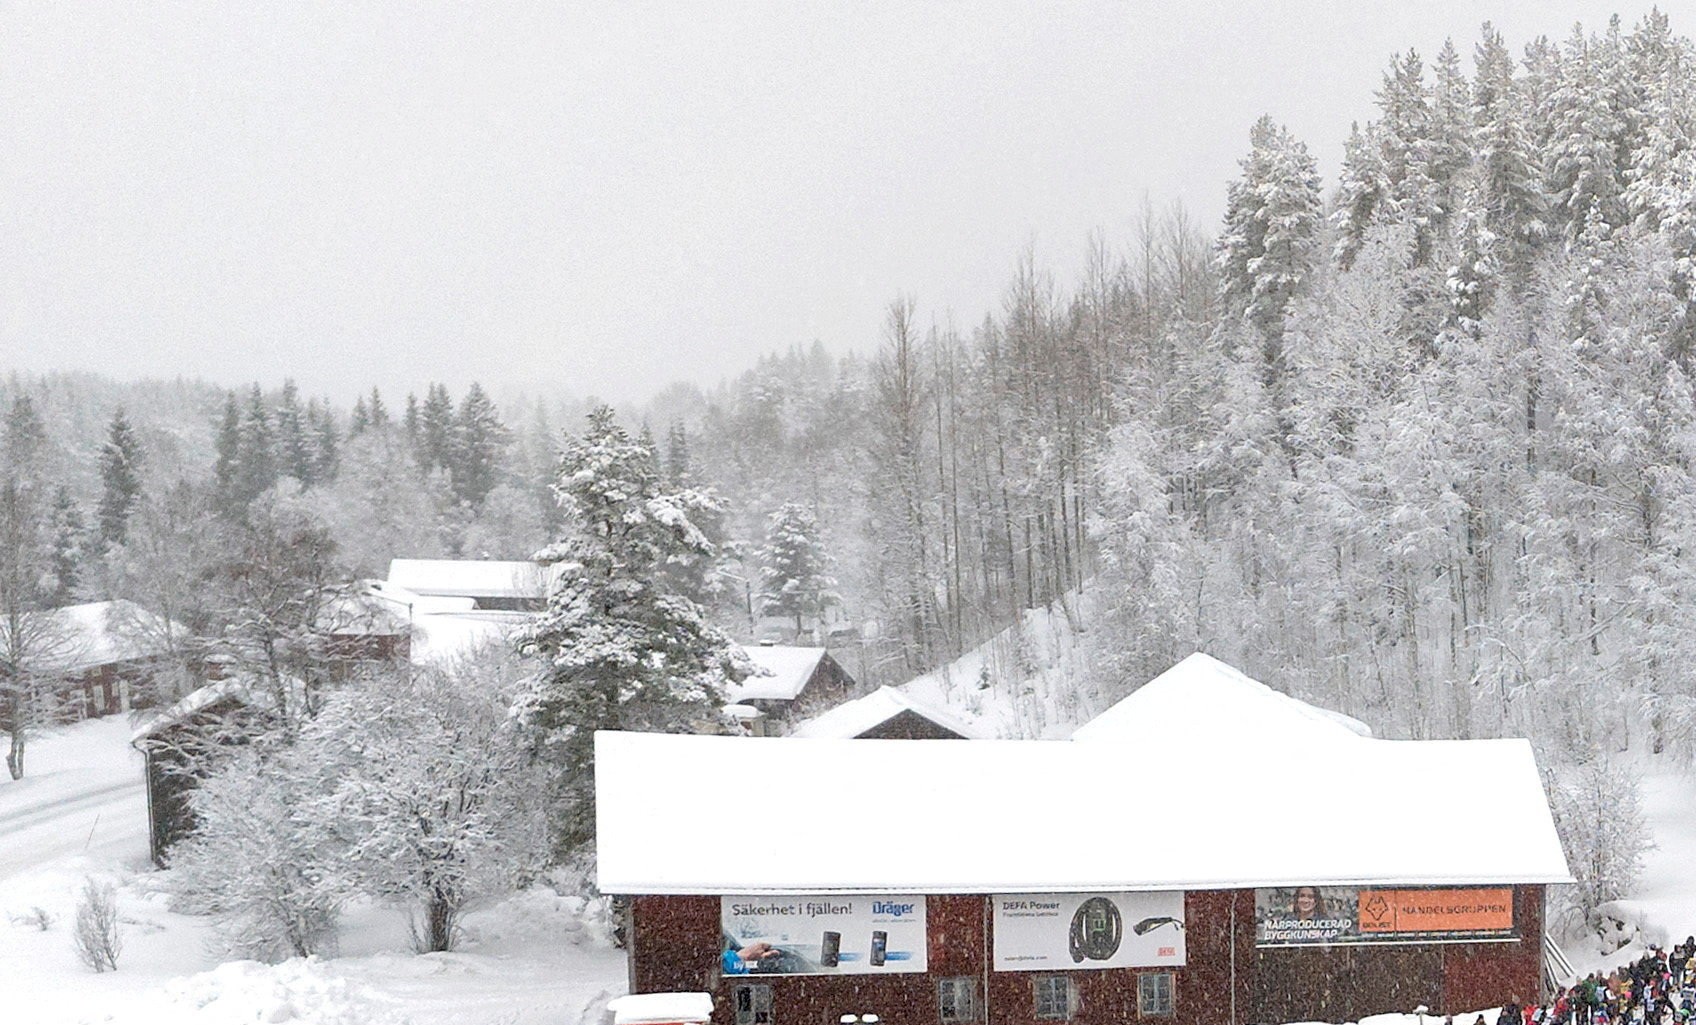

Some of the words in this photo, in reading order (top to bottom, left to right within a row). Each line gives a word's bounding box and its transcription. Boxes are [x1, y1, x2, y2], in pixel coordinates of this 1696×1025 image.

[732, 903, 795, 916] Säkerhet
[806, 902, 852, 918] fjällen!
[872, 901, 914, 916] Dräger
[1003, 901, 1027, 910] DEFA
[1029, 901, 1060, 910] Power
[1402, 904, 1506, 915] HANDELSGRUPPEN
[1264, 929, 1338, 940] BYGGKUNSKAP
